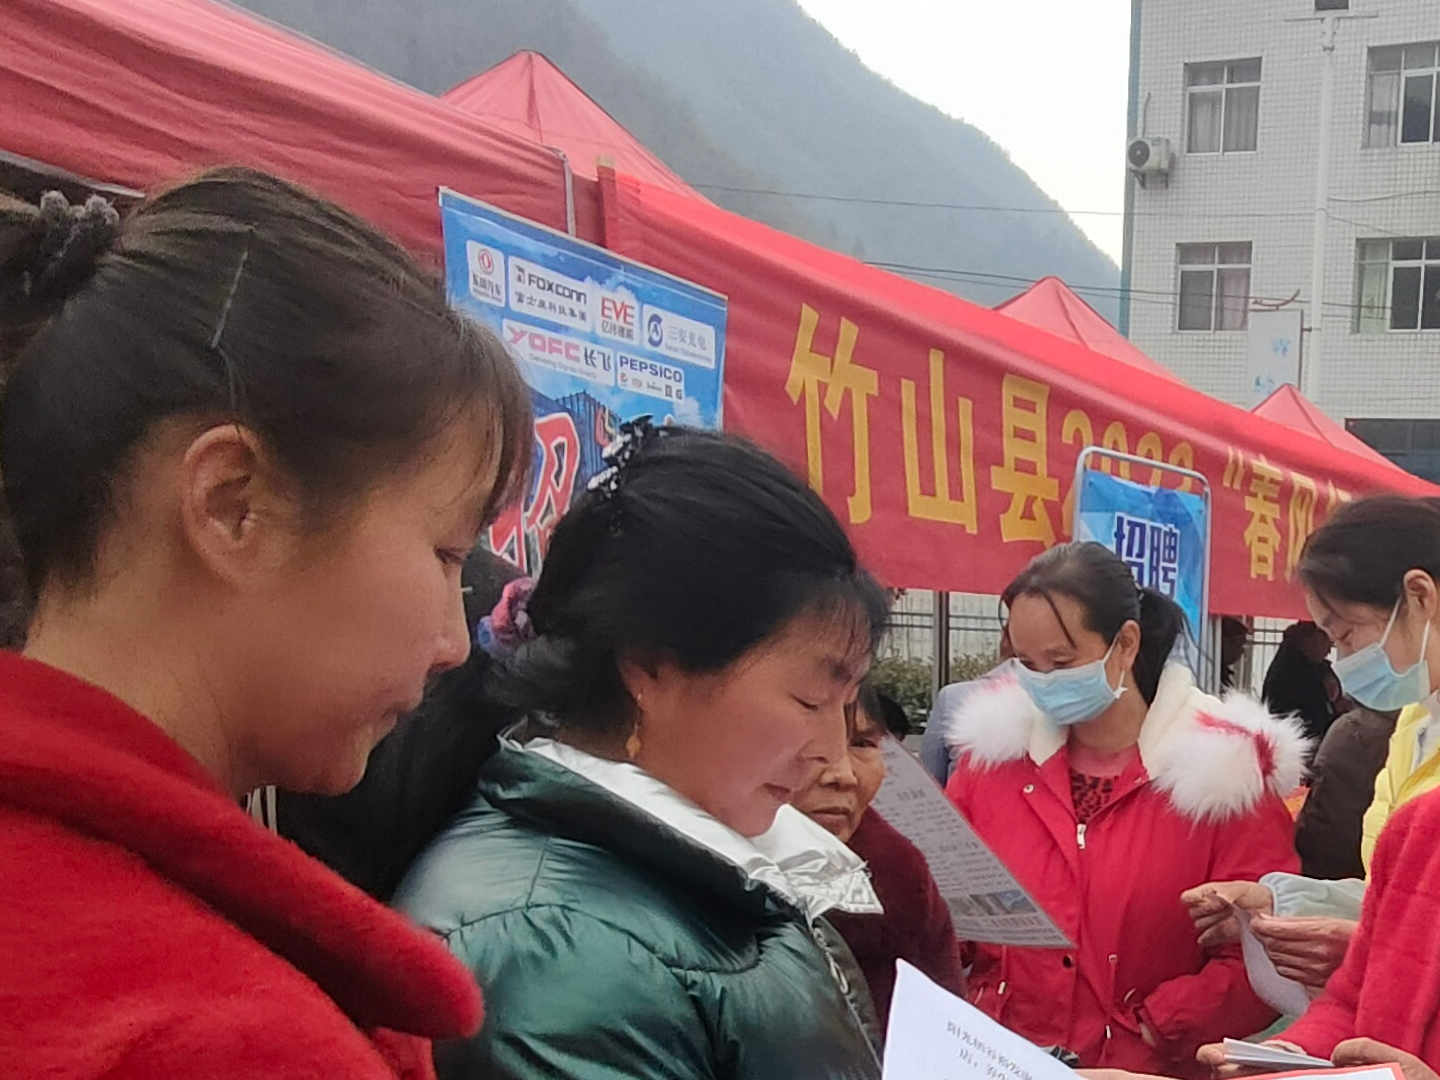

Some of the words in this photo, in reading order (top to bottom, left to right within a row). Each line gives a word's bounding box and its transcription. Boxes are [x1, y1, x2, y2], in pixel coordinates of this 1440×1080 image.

[601, 297, 635, 326] EVE
[508, 325, 581, 363] YOFC
[620, 355, 683, 382] PEPSICO
[1113, 513, 1180, 598] 招聘
